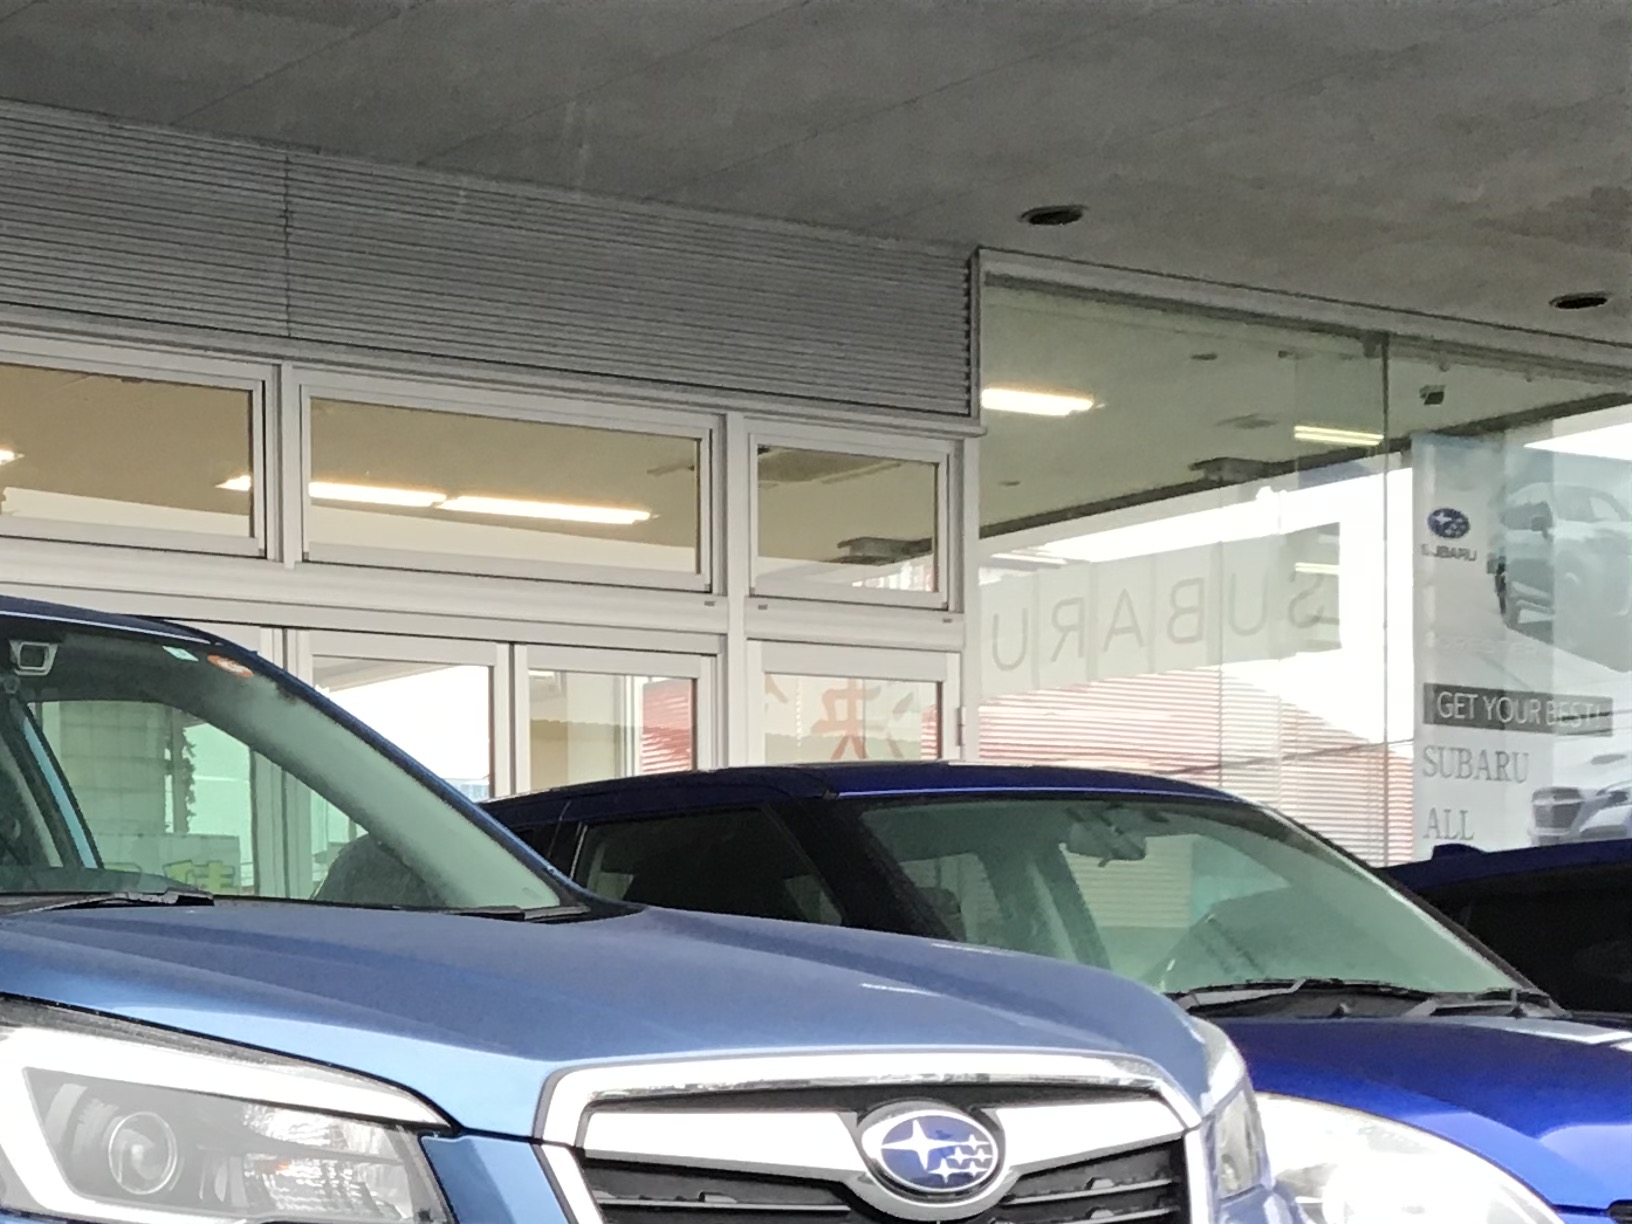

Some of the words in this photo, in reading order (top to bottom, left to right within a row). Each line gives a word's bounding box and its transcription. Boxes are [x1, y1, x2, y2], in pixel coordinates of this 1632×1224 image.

[1436, 690, 1479, 721] GET
[1481, 694, 1542, 725] YOUR
[1421, 744, 1530, 785] SUBARU
[1422, 806, 1475, 841] ALL
